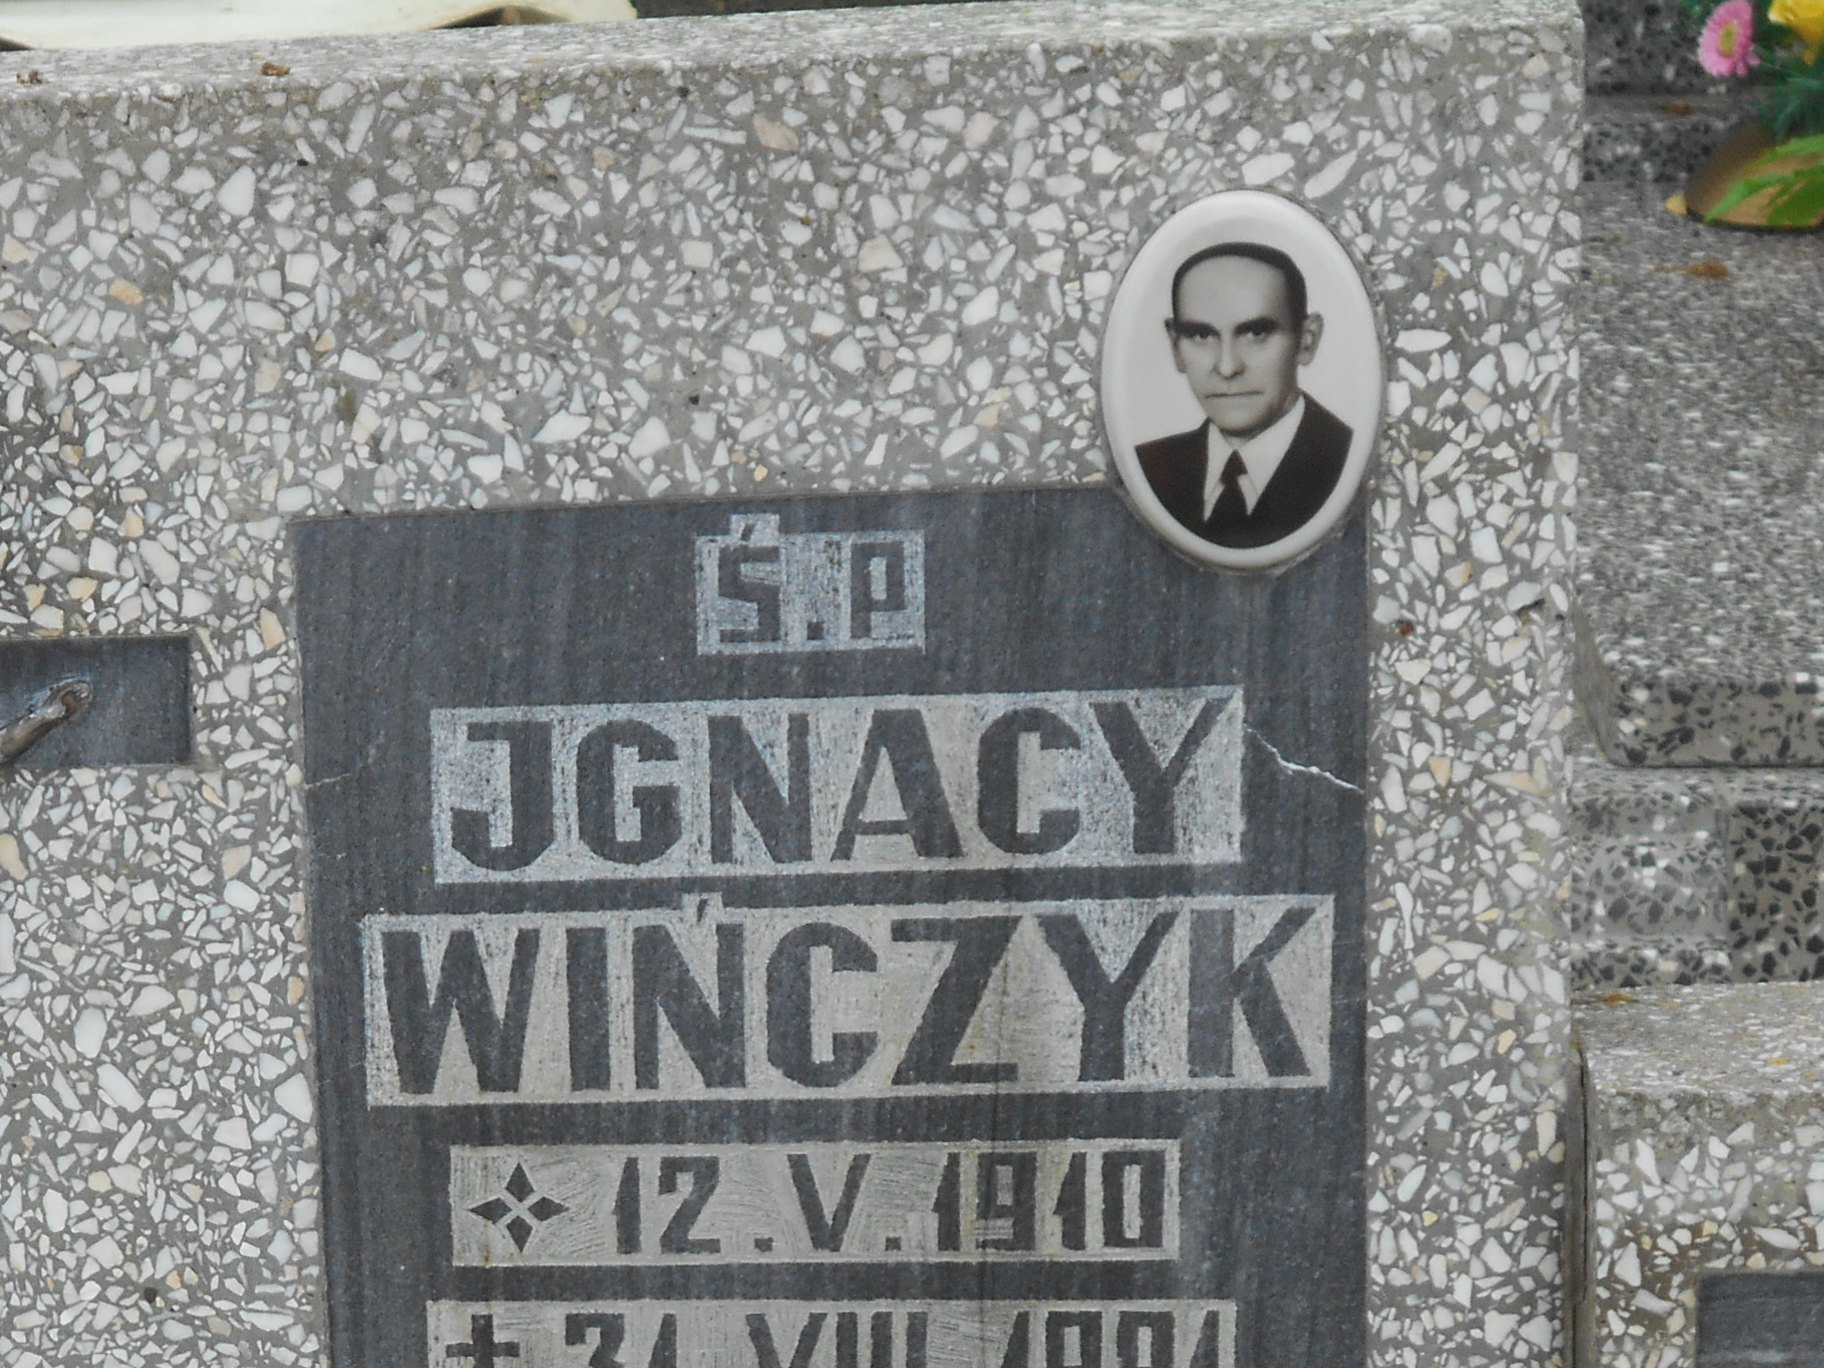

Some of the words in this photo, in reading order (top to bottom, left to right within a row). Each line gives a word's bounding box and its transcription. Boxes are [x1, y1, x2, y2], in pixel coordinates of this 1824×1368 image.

[717, 521, 906, 643] Ś.P
[450, 695, 1231, 872] JGNACY
[382, 896, 1317, 1094] WIŃCZYK
[614, 1150, 1165, 1255] 12.V.1910
